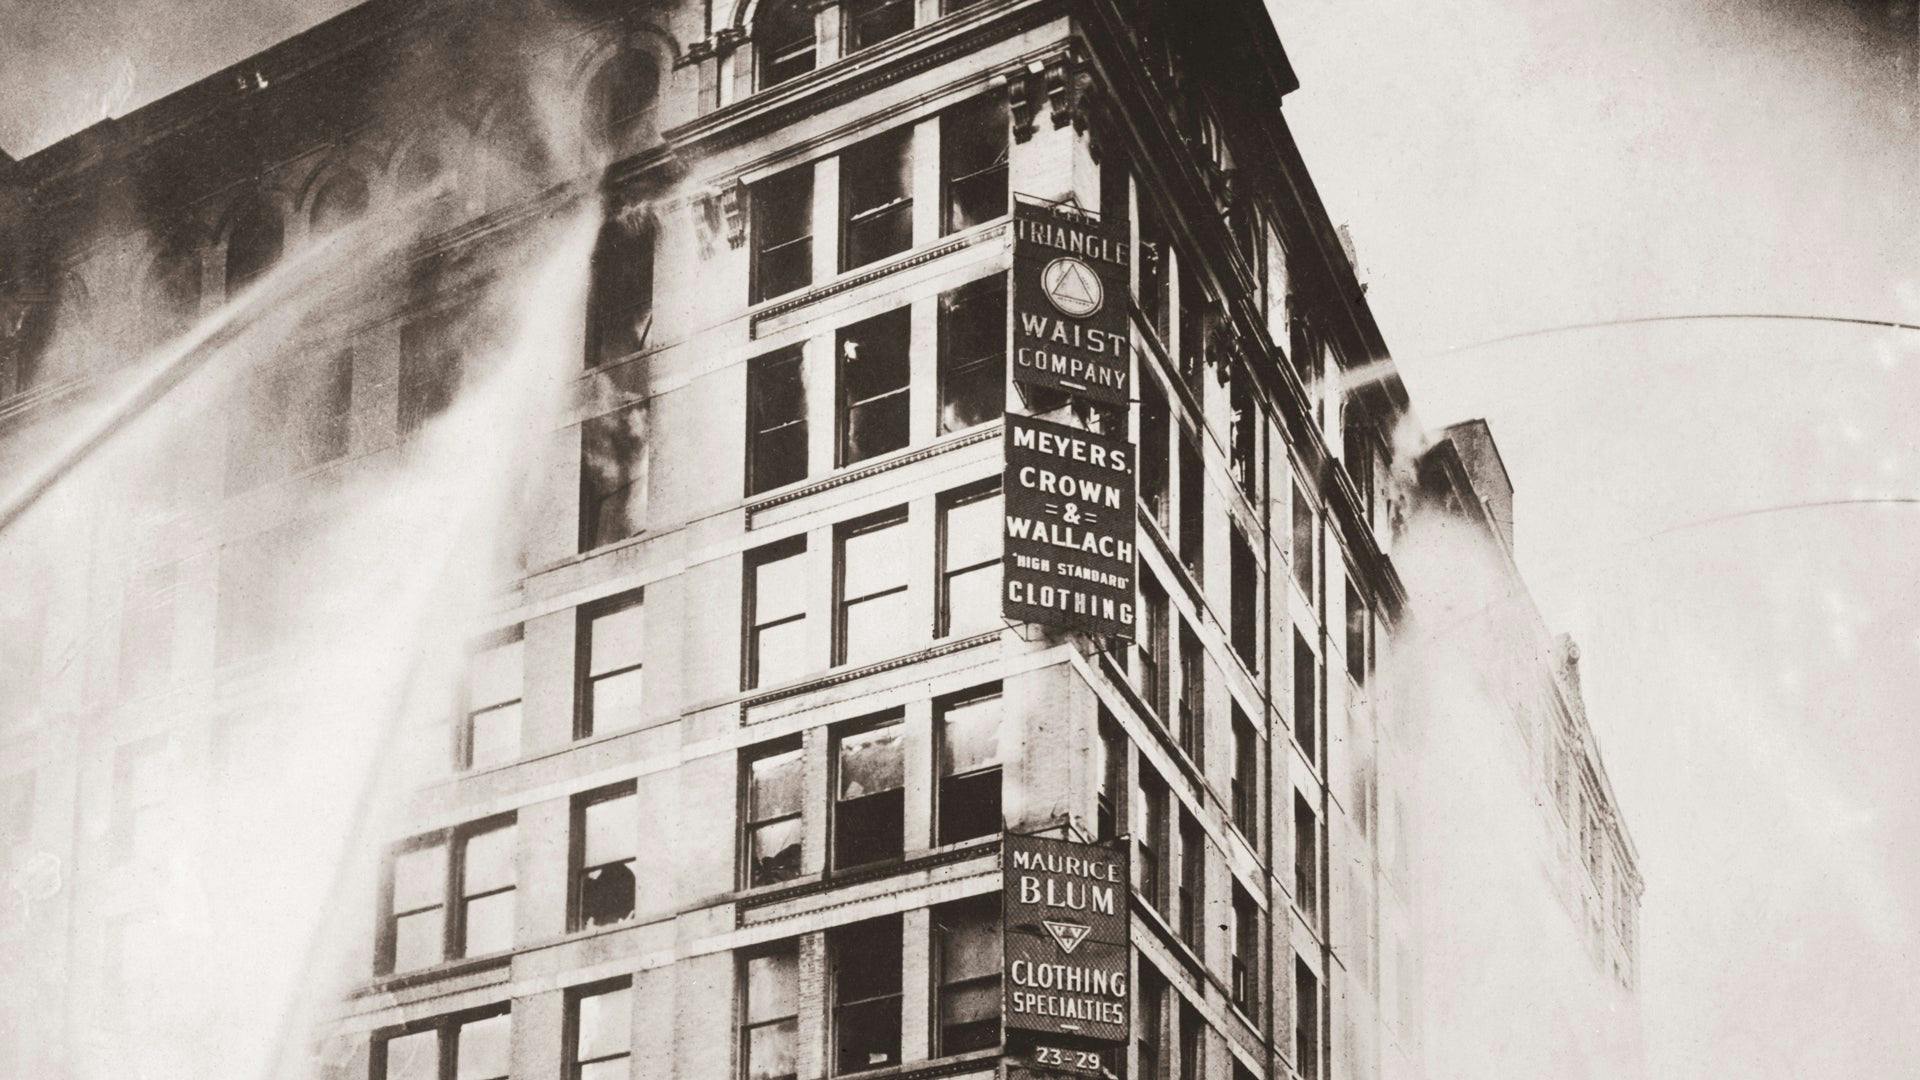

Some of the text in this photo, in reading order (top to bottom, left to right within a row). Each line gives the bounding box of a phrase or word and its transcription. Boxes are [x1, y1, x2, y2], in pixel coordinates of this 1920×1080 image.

[1016, 217, 1129, 265] TRIANGLE
[1021, 312, 1126, 357] WAIST
[1018, 347, 1126, 390] COMPANY
[1019, 466, 1121, 510] CROWN
[1062, 502, 1081, 525] &
[1006, 515, 1132, 564] WALLACH
[1008, 580, 1134, 625] CLOTHING
[1013, 850, 1121, 883] MAURICE
[1020, 875, 1115, 916] BLUM
[1011, 959, 1126, 998] CLOTHING
[1013, 991, 1124, 1025] SPECIALTIES
